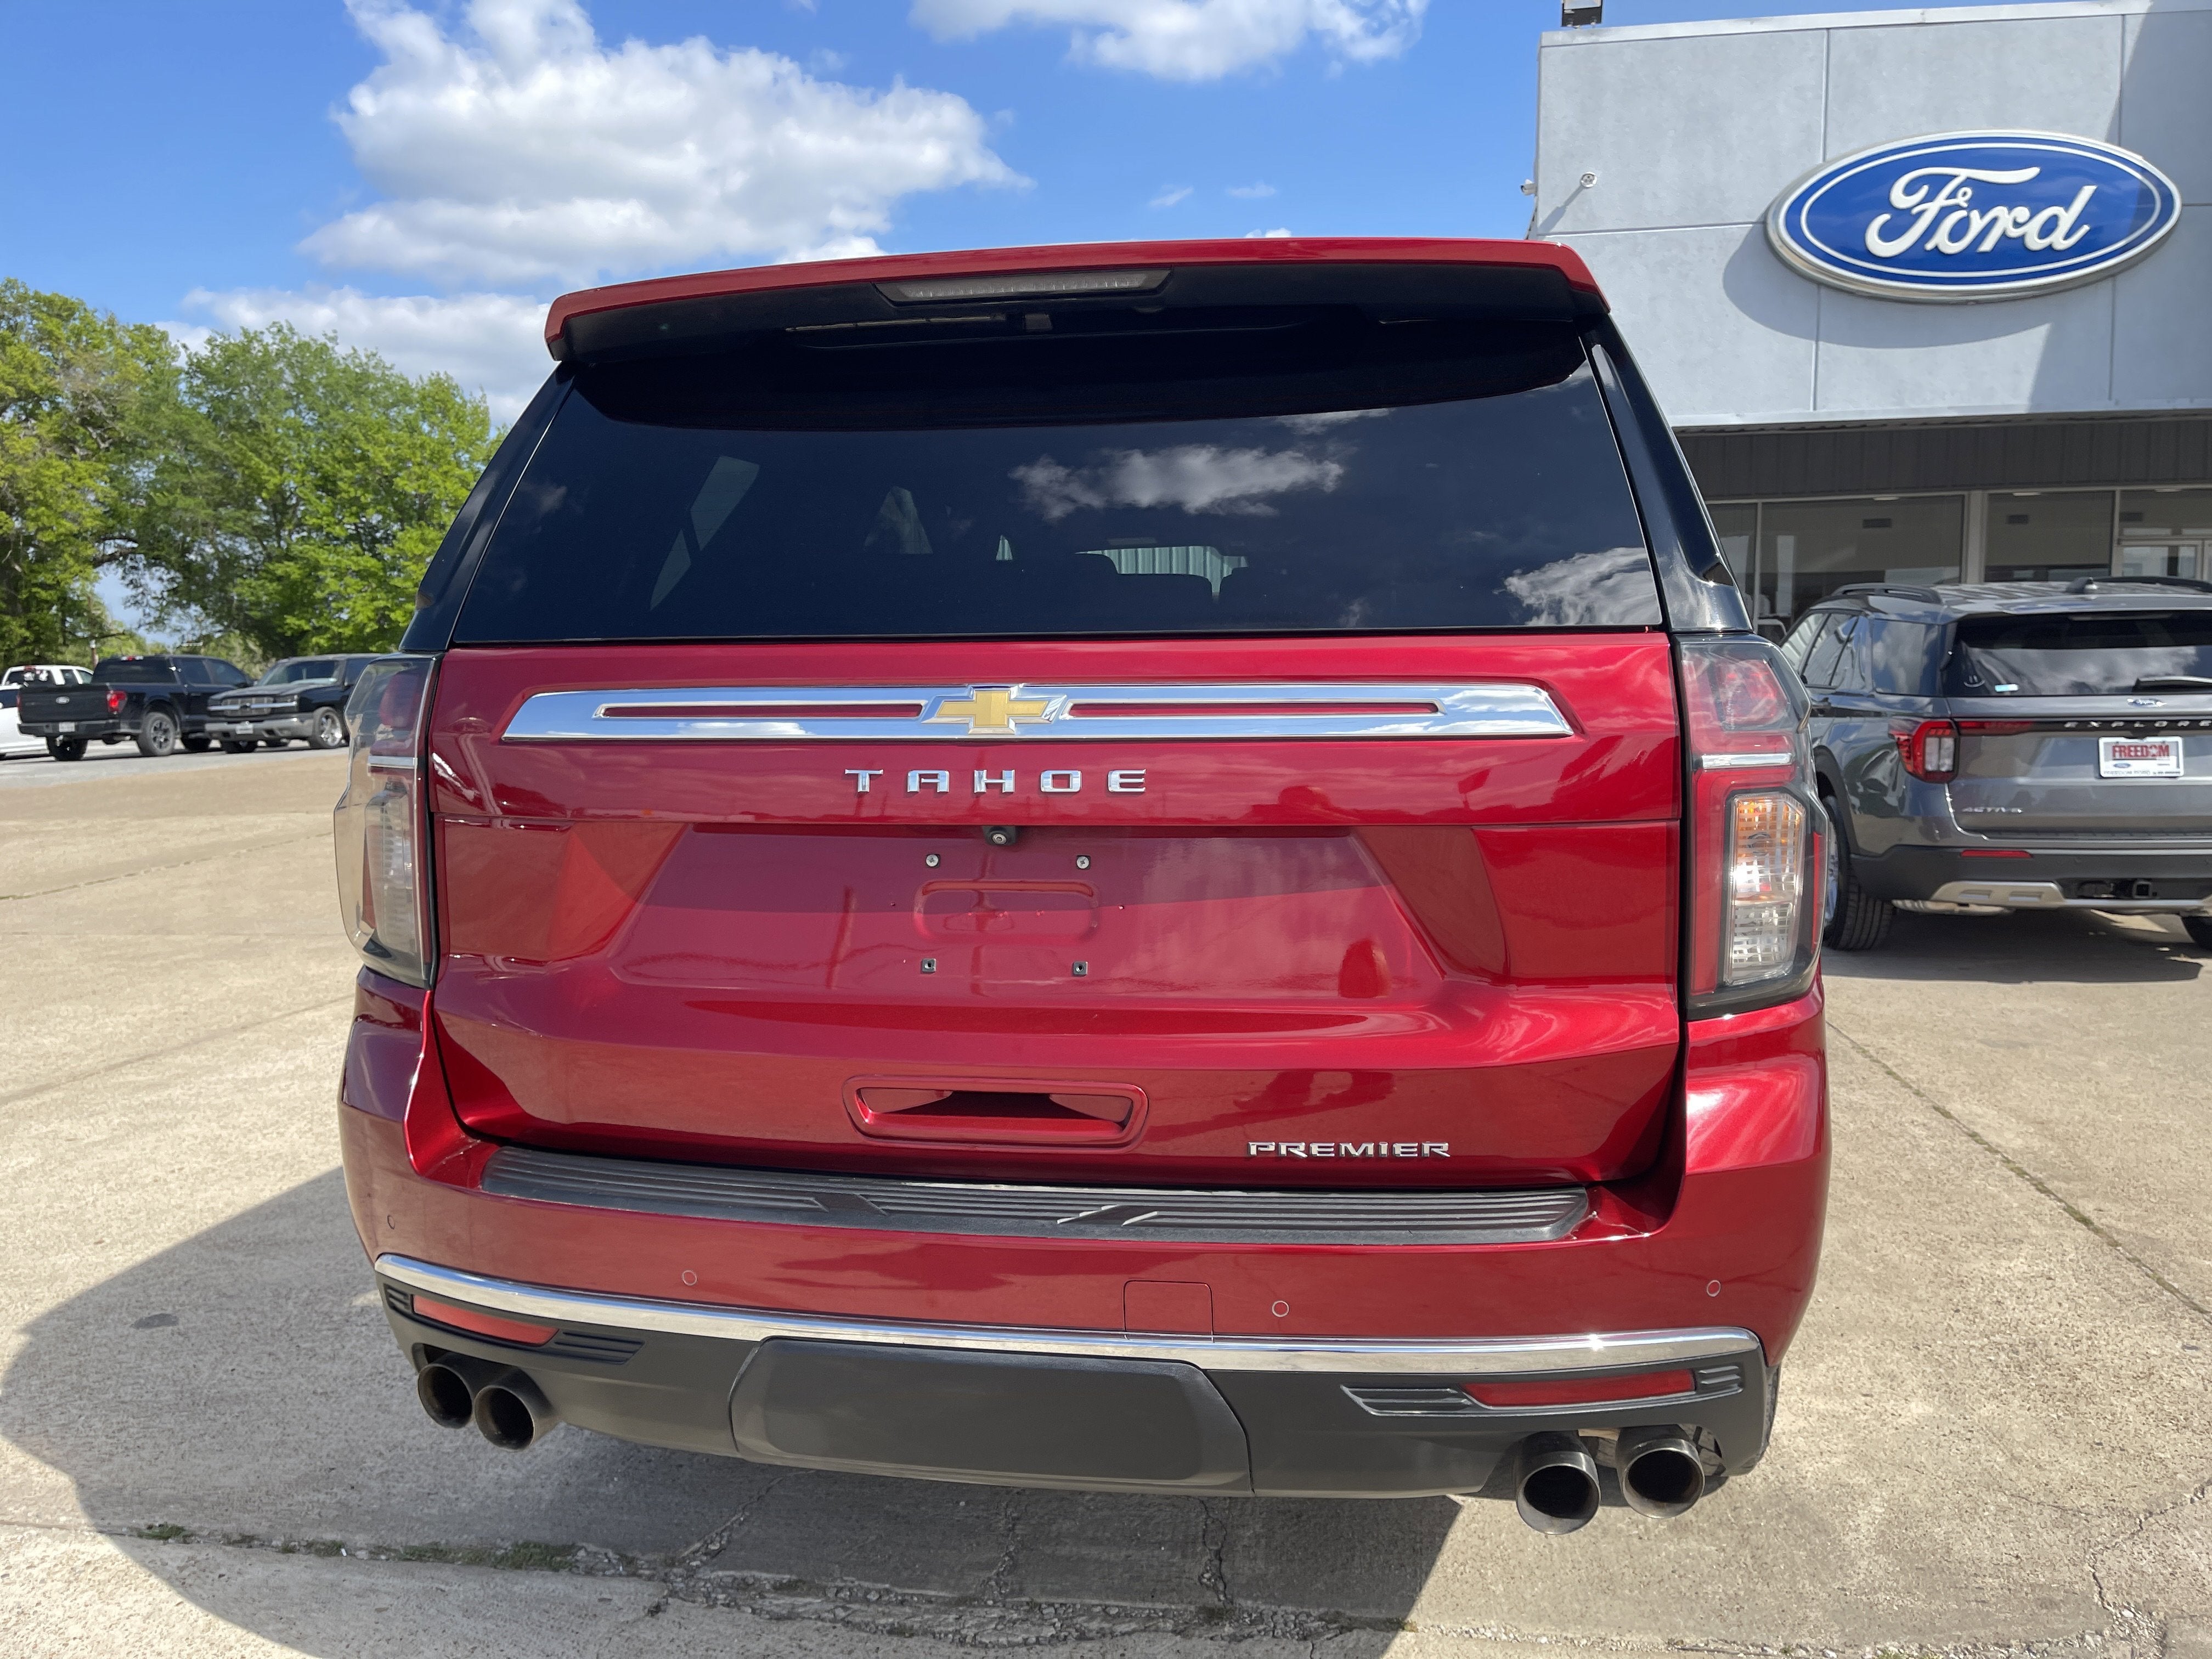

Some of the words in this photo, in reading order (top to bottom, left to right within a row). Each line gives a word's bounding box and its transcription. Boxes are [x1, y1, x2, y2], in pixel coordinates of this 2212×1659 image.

[1865, 166, 2098, 258] Ford
[2113, 745, 2169, 757] FREEDOM
[845, 769, 1146, 793] TAHOE
[1248, 1142, 1451, 1158] PREMIER
